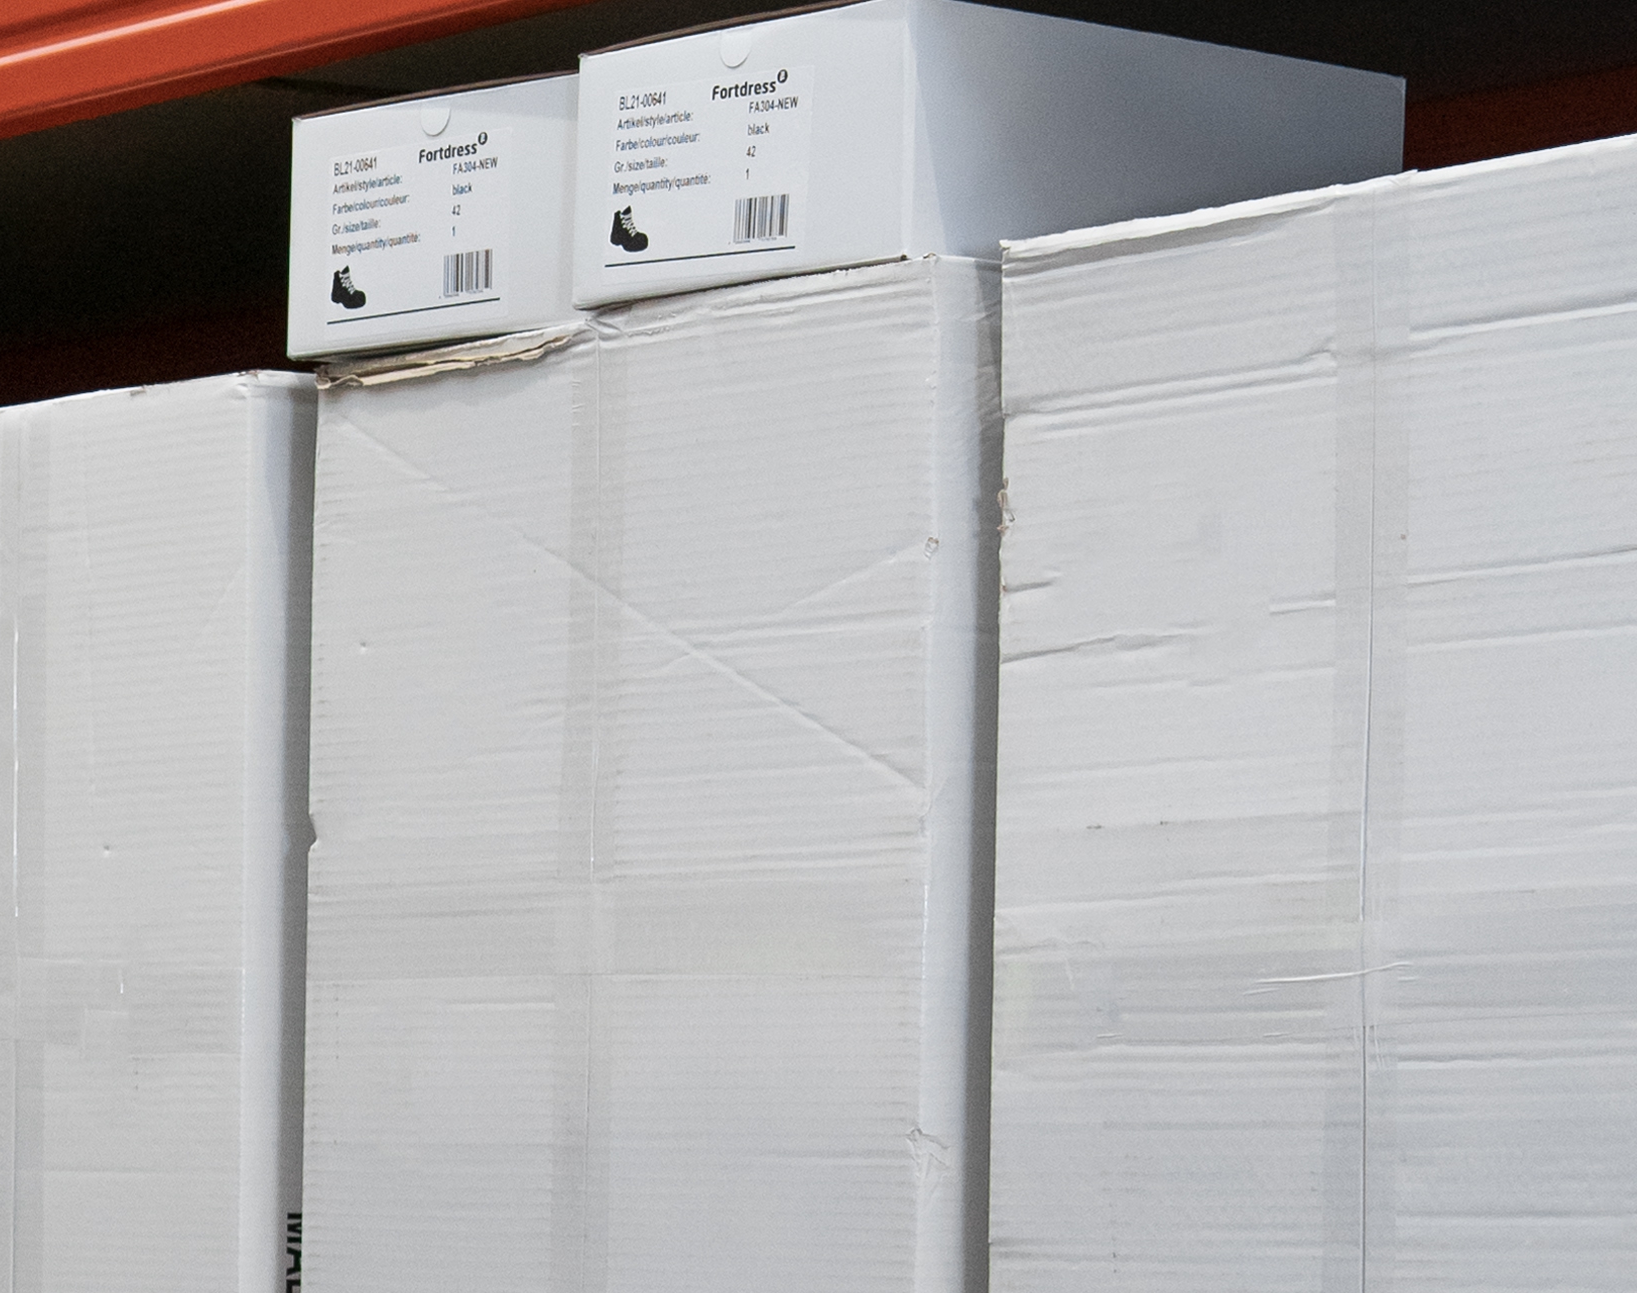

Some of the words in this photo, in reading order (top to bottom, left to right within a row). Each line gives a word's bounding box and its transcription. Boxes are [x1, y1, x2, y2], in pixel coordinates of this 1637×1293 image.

[712, 80, 776, 100] Fortdress
[617, 111, 694, 130] Artikel/style/article:
[748, 96, 799, 114] FA304-NEW
[615, 133, 700, 151] Farbe/colour/couleur:
[747, 122, 770, 136] black
[418, 141, 477, 163] Fortdress
[614, 157, 668, 173] Gr./size/taille:
[746, 146, 756, 157] 42
[333, 175, 403, 195] Artikel/style/article:
[452, 157, 498, 175] FA304-NEW
[332, 195, 410, 215] Farbe/colour/couleur:
[452, 183, 472, 195] black
[451, 205, 461, 216] 42
